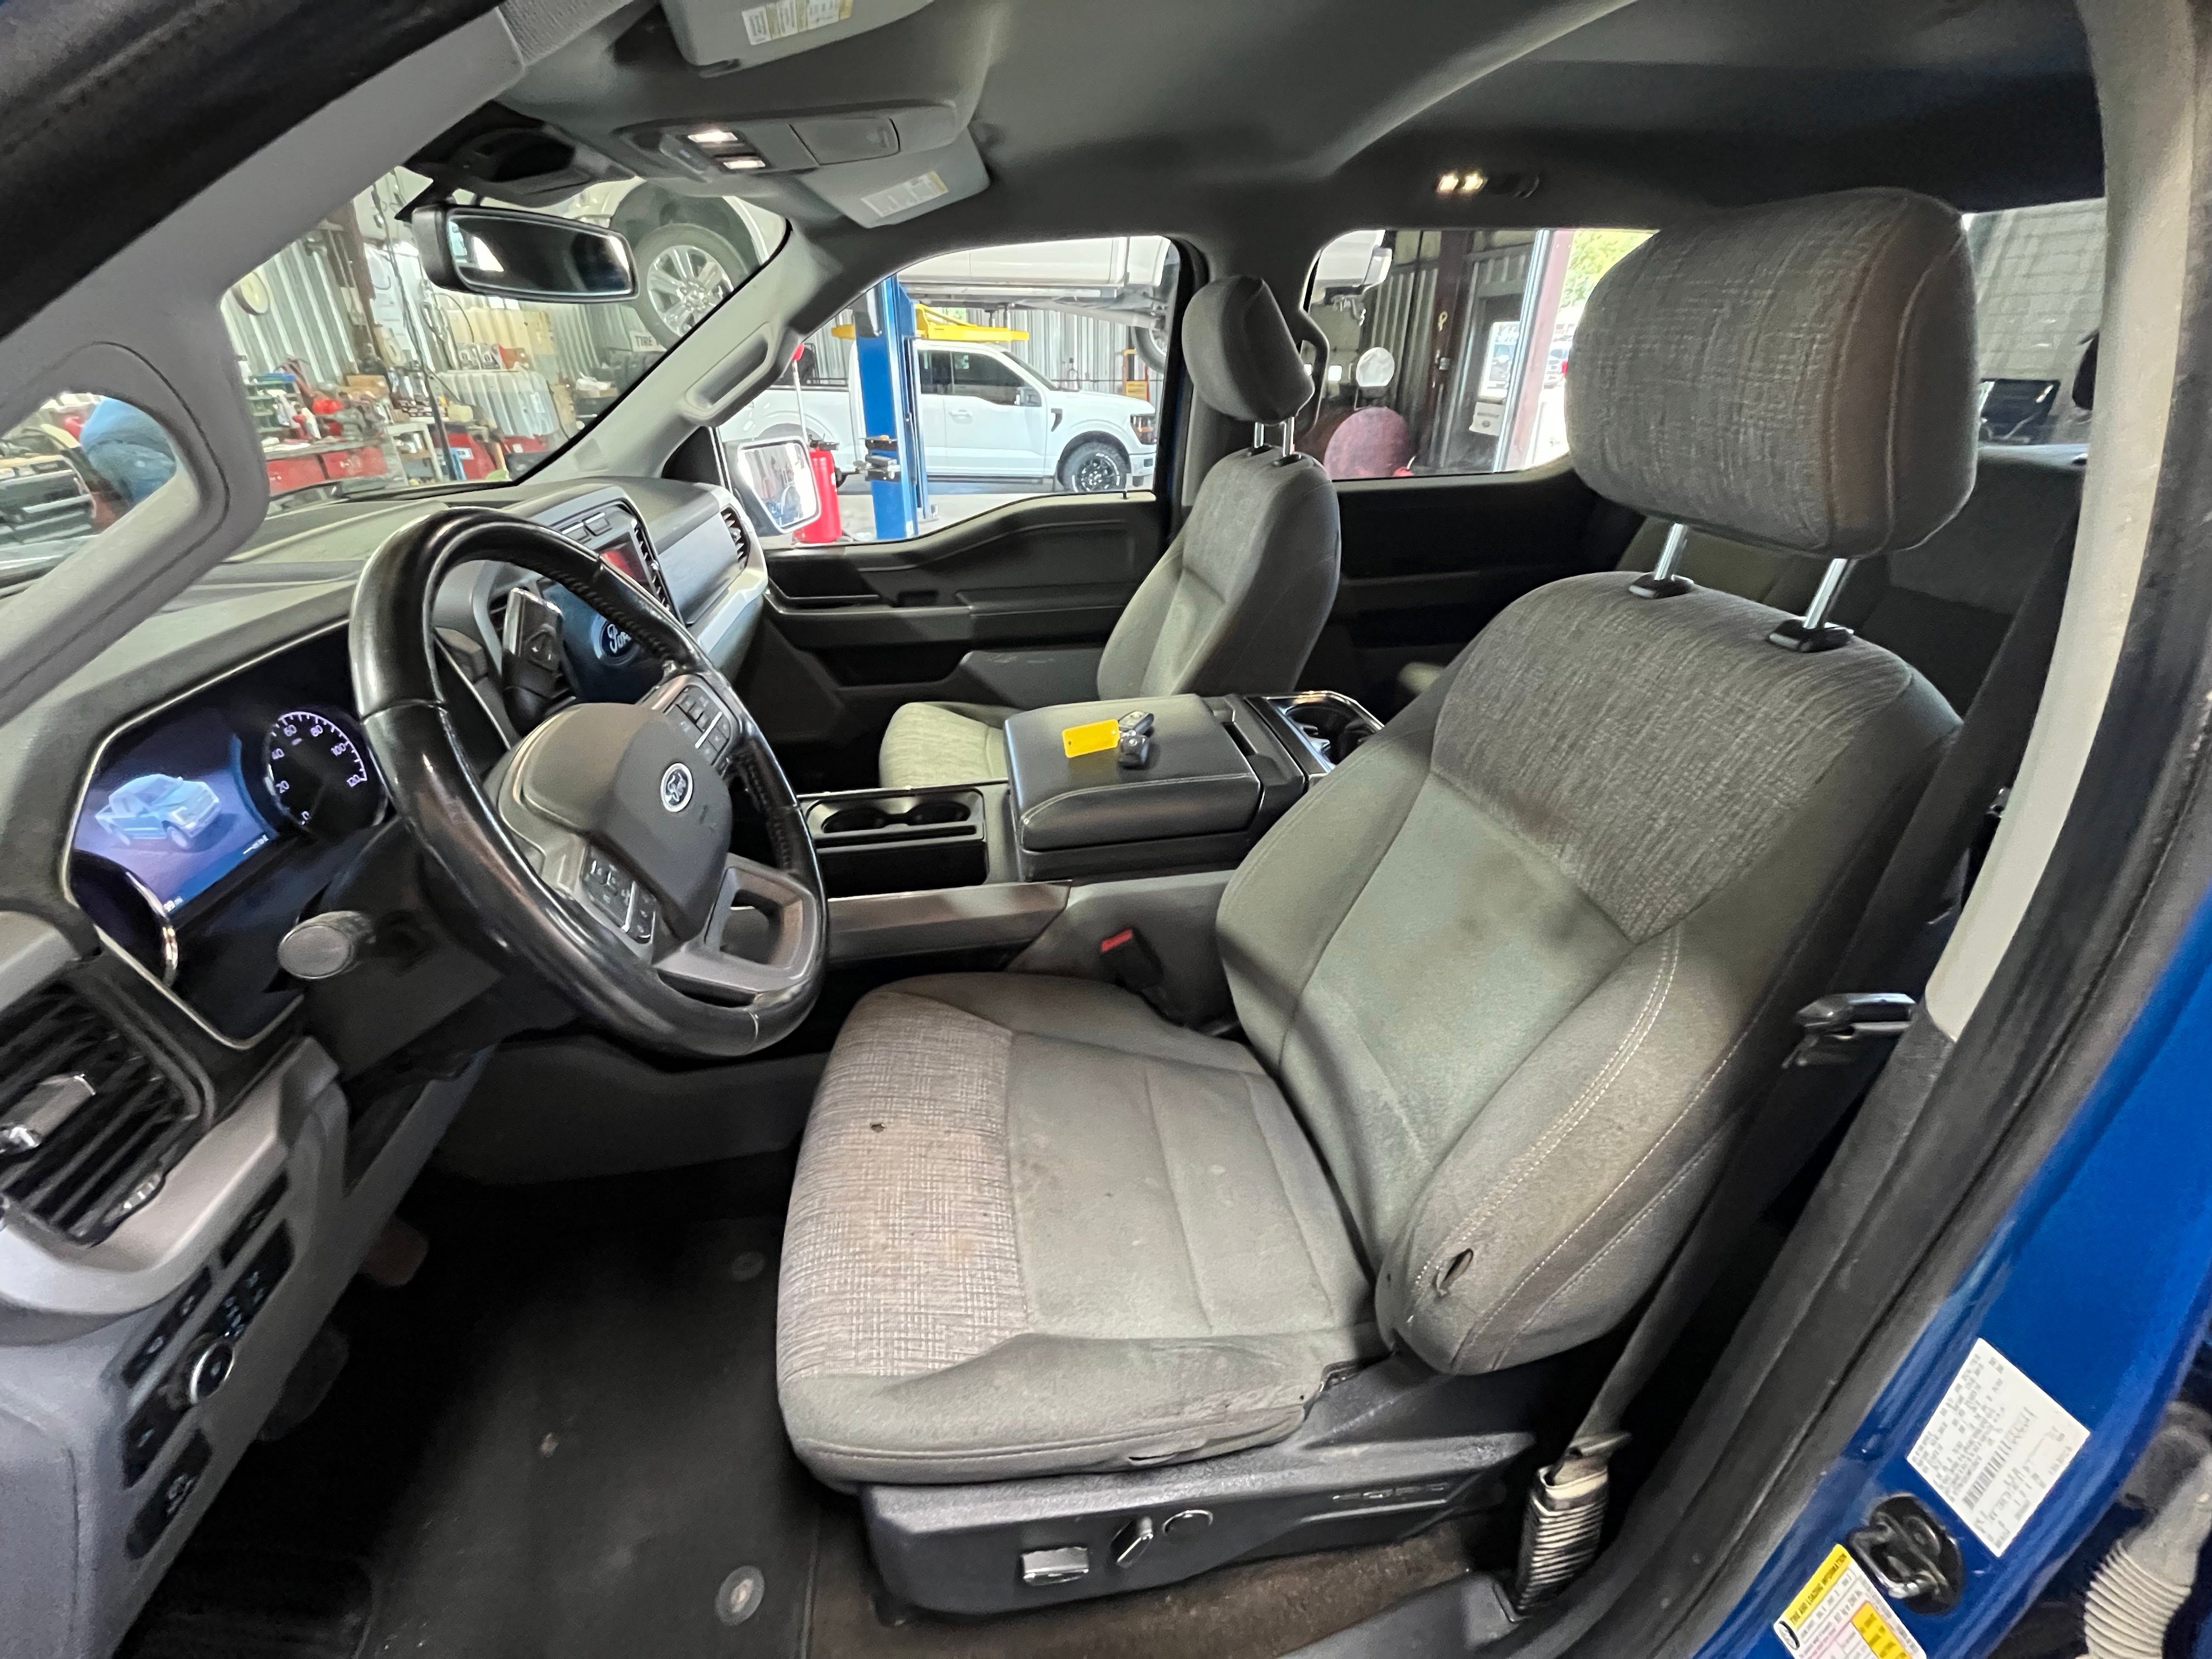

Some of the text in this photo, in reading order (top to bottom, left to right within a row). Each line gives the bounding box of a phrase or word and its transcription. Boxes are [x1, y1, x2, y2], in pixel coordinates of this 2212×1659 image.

[284, 724, 297, 737] 60
[311, 725, 324, 737] 80
[331, 743, 346, 756] 100
[276, 781, 289, 793] 20
